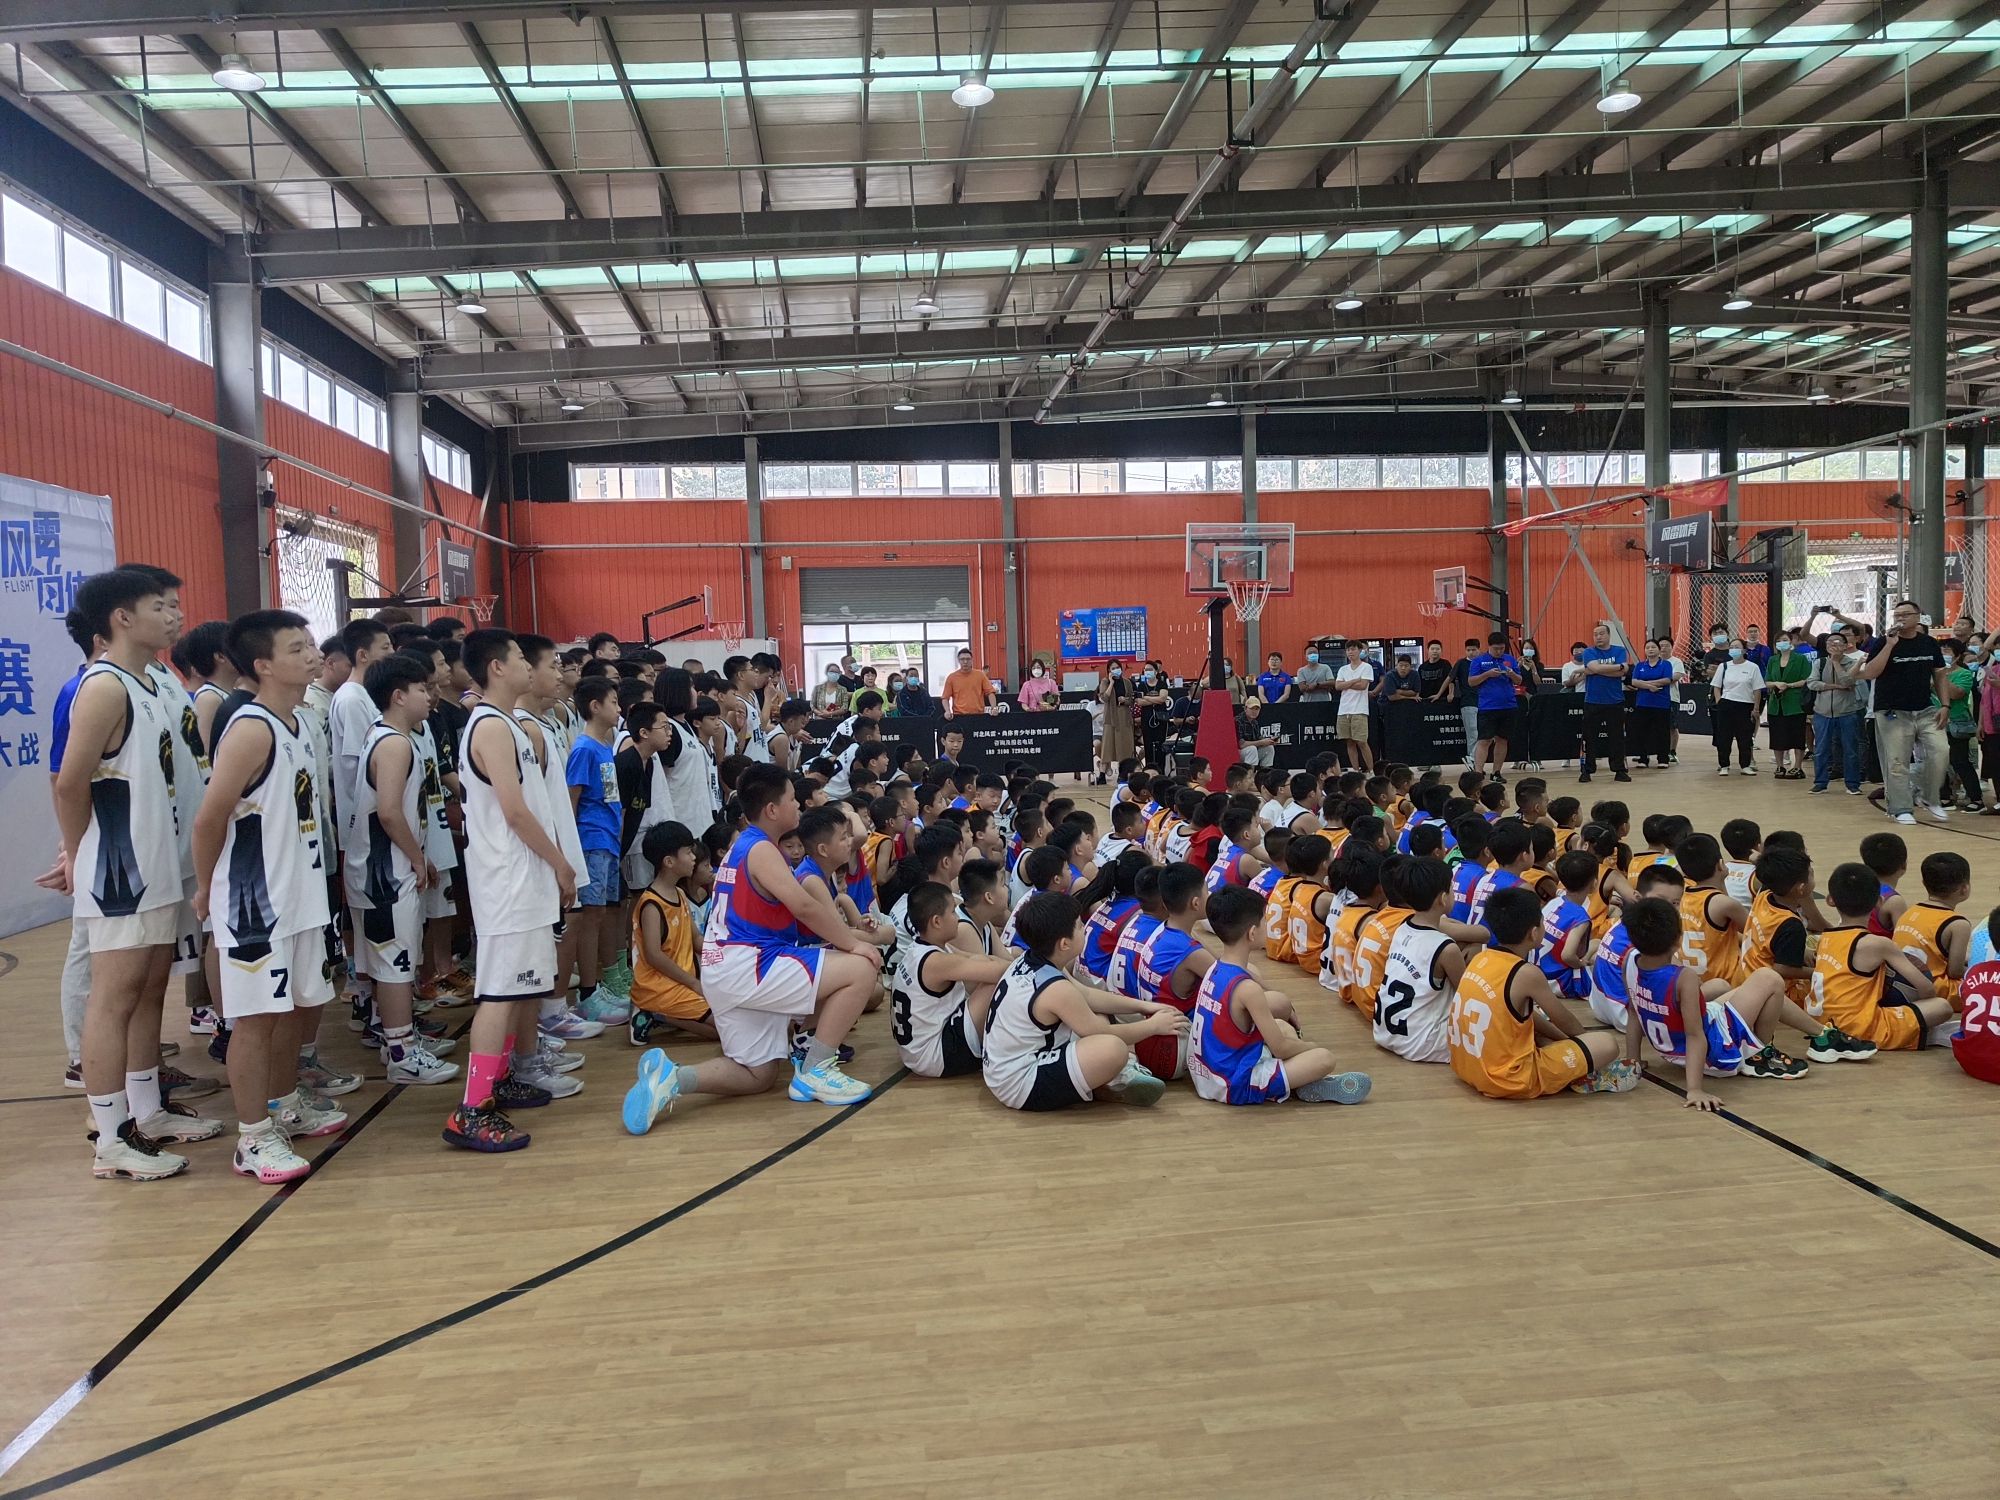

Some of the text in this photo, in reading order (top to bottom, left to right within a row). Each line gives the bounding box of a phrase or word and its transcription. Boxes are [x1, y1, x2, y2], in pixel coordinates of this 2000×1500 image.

[393, 949, 410, 972] 4
[1113, 953, 1127, 989] 6
[270, 967, 289, 998] 7
[1448, 991, 1492, 1059] 33
[1965, 993, 2000, 1036] 25
